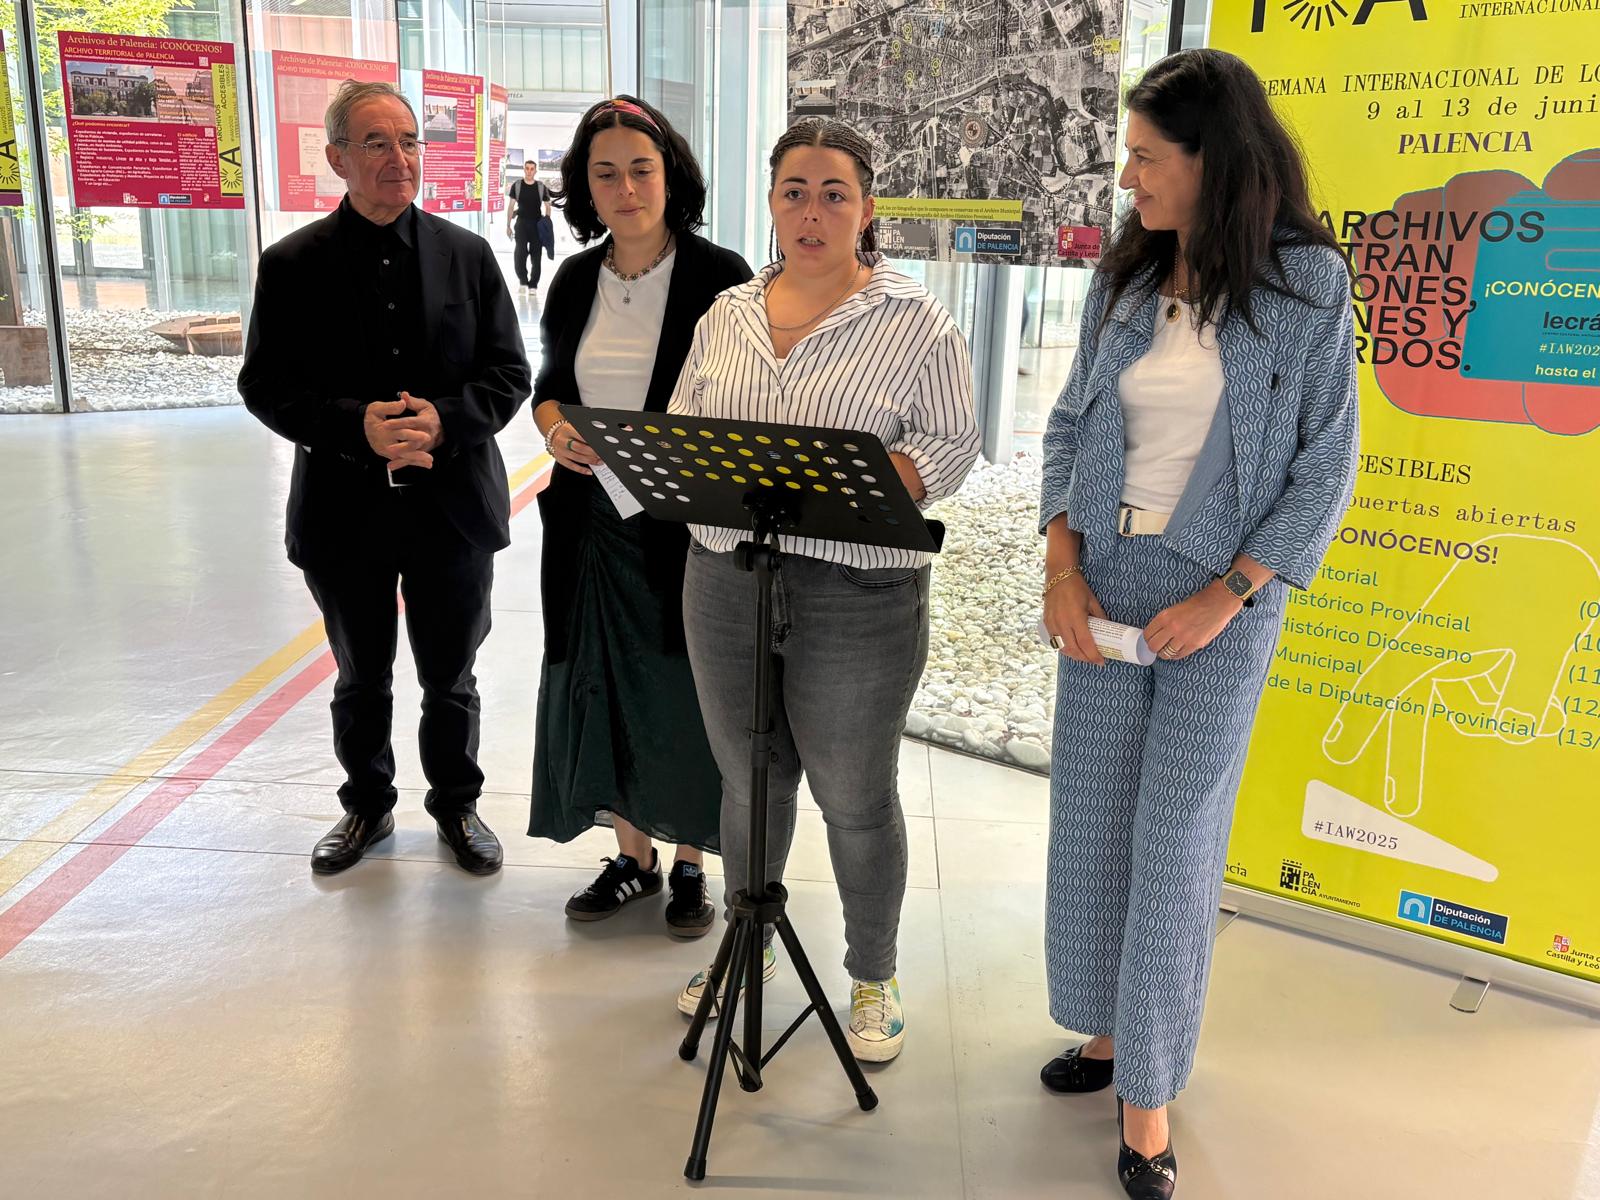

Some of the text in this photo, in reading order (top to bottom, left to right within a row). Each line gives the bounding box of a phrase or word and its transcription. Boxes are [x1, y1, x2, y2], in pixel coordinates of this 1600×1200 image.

[64, 46, 93, 54] ARCHIVO
[94, 48, 134, 57] TERRITORIAL
[145, 52, 175, 60] PALENCIA
[67, 35, 222, 54] Archivos de Palencia: ¡CONÓCENOS!
[218, 64, 227, 110] ACCESIBLES
[1341, 67, 1519, 92] INTERNACIONAL
[1534, 65, 1564, 84] DE
[1367, 94, 1599, 120] 9 al 13 de juni
[215, 104, 223, 142] ARCHIVOS
[1397, 131, 1533, 154] PALENCIA
[977, 232, 1011, 242] Diputación
[1317, 210, 1545, 243] ARCHIVOS
[977, 242, 1019, 251] DE PALENCIA
[1350, 273, 1477, 313] ONES,
[1442, 308, 1469, 339] Y
[1535, 364, 1596, 379] hasta el
[1455, 505, 1577, 534] abiertas
[1333, 527, 1500, 565] ONÓCENOS!
[1318, 564, 1379, 587] itorial
[1370, 601, 1471, 633] Provincial
[1367, 631, 1472, 664] Diocesano
[1267, 674, 1600, 738] de la Diputación Provincial (12
[1313, 820, 1399, 850] #IAW2025
[1302, 878, 1321, 890] LEN
[1303, 870, 1315, 882] PA
[1301, 886, 1361, 908] CIA AYUNTAMIENTO
[1434, 914, 1503, 939] DE PALENCIA
[1435, 904, 1491, 926] Diputación
[1546, 950, 1576, 963] Castilla
[1570, 949, 1595, 960] Junta
